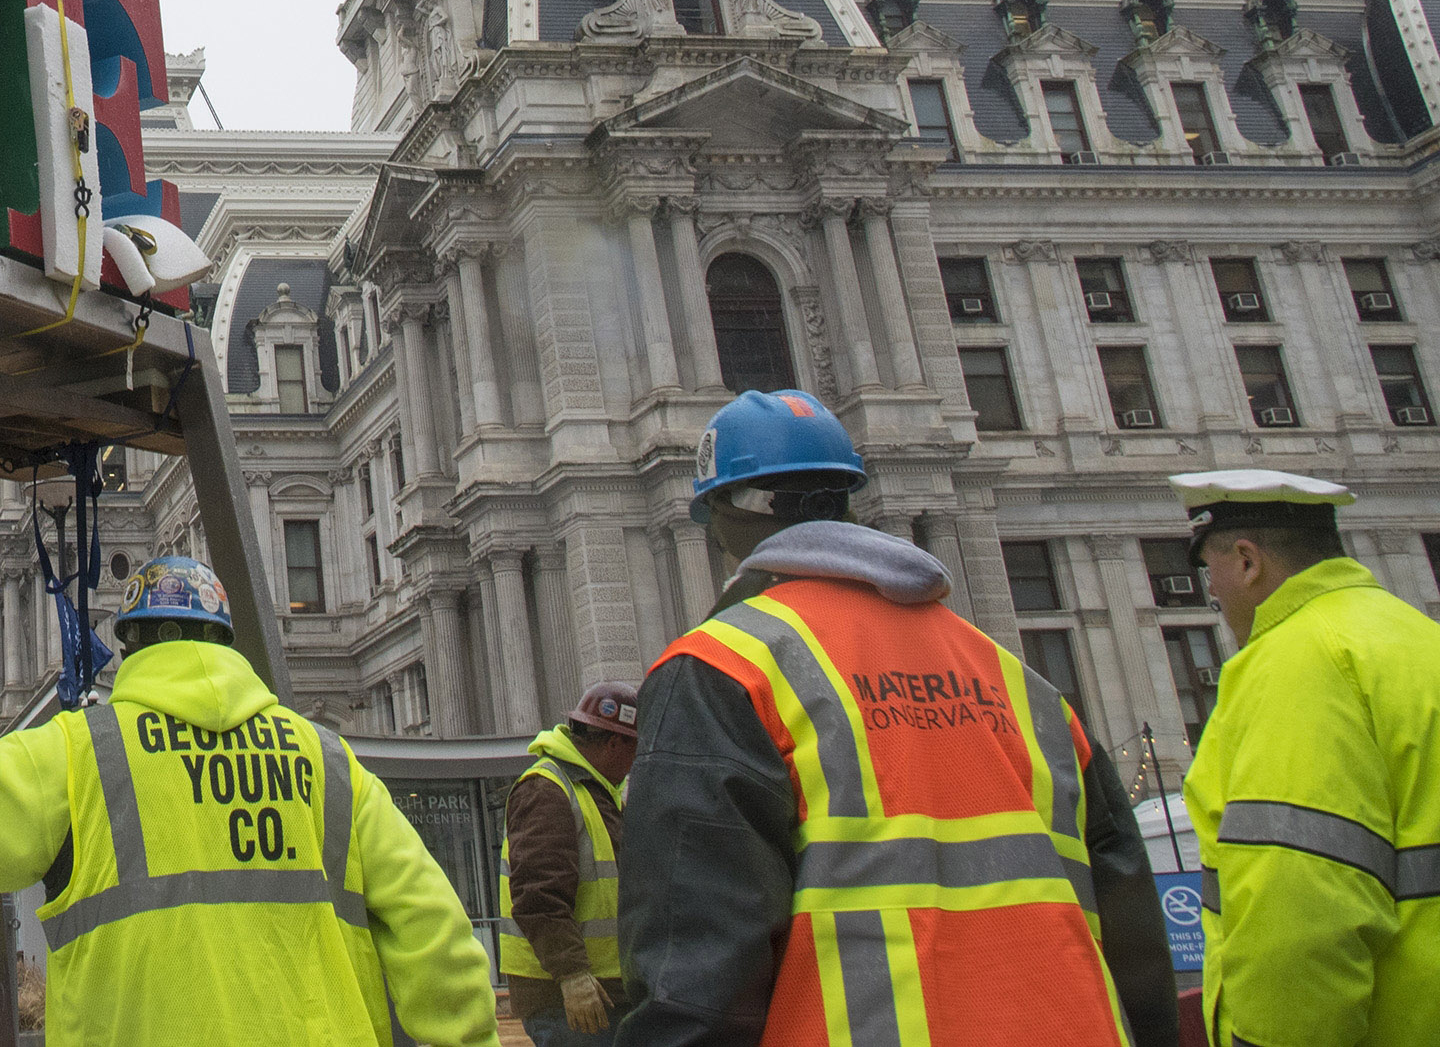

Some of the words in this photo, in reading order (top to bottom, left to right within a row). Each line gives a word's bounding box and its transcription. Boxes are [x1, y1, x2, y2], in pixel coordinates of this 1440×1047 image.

[864, 702, 1019, 735] CONSERVAON
[136, 711, 300, 754] GEORGE
[181, 754, 313, 807] YOUNG
[393, 796, 424, 810] RTH
[428, 795, 470, 810] PARK
[426, 813, 471, 824] CENTER
[228, 807, 297, 862] CO.
[1168, 942, 1205, 952] MOKE-F
[1169, 932, 1192, 941] THIS
[1192, 931, 1202, 940] IS
